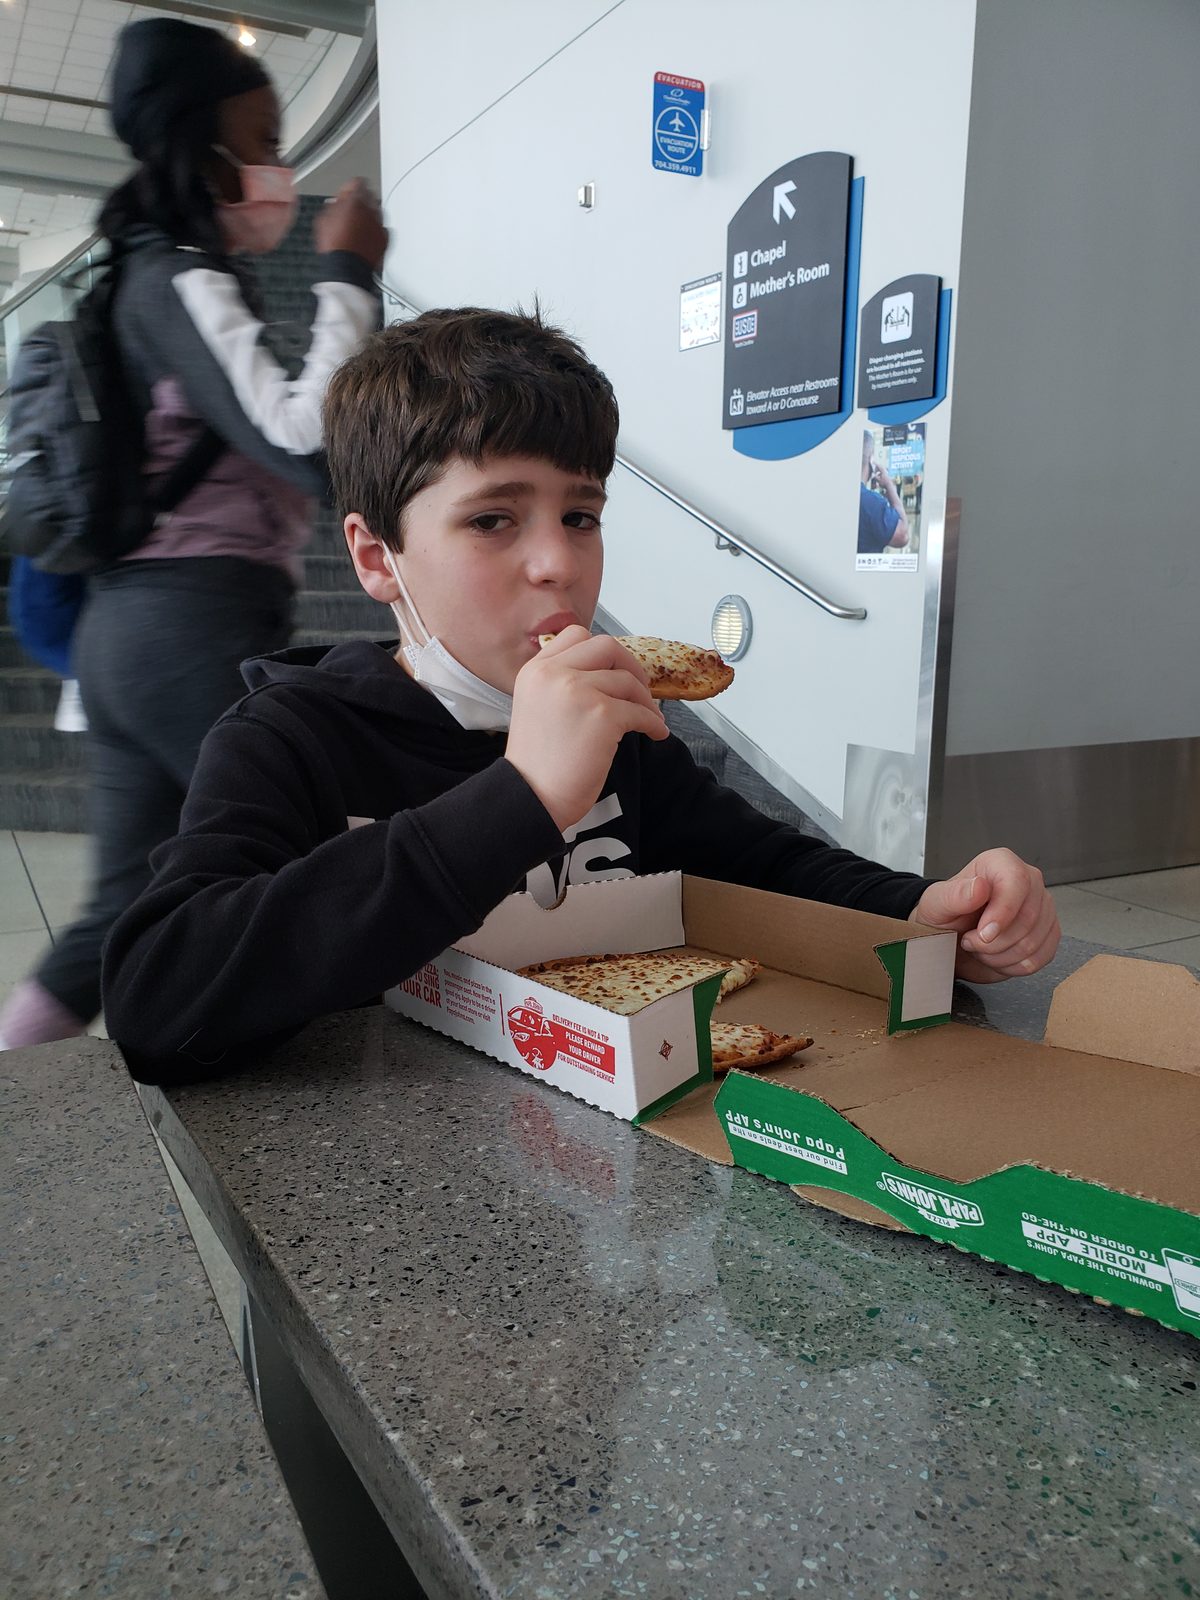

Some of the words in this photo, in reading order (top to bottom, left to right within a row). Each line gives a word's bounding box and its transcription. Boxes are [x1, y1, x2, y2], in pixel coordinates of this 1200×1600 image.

[657, 73, 702, 89] EVACUATION
[660, 137, 693, 149] EVACUATION
[667, 145, 686, 154] ROUTE
[750, 240, 787, 267] Chapel
[749, 271, 795, 299] Mother's
[796, 263, 830, 284] Room
[746, 390, 770, 402] Elevator
[769, 386, 791, 398] Access
[790, 383, 805, 394] near
[804, 377, 839, 391] Restrooms
[746, 402, 768, 415] toward
[767, 401, 773, 411] A
[773, 402, 780, 411] or
[780, 399, 787, 409] D
[787, 395, 819, 408] Concourse
[424, 973, 440, 989] SING
[423, 986, 442, 1008] CAR
[552, 1013, 573, 1028] DELIVERY
[573, 1022, 582, 1032] FEE
[582, 1025, 587, 1034] IS
[587, 1027, 597, 1039] NOT
[597, 1032, 602, 1041] A
[601, 1034, 609, 1043] TIP
[565, 1031, 584, 1046] PLEASE
[583, 1039, 605, 1055] REWARD
[568, 1044, 582, 1056] YOUR
[582, 1050, 601, 1065] DRIVER
[557, 1053, 567, 1062] FOR
[566, 1055, 596, 1076] OUTSTANDING
[596, 1069, 615, 1084] SERVICE
[725, 1109, 749, 1127] APP
[732, 1126, 746, 1136] the
[747, 1131, 758, 1140] on
[753, 1118, 801, 1144] John's
[759, 1135, 781, 1149] deals
[784, 1144, 804, 1157] best
[806, 1135, 846, 1161] Papa
[806, 1152, 821, 1162] our
[824, 1158, 843, 1171] Find
[938, 1195, 980, 1221] PAPA
[927, 1213, 951, 1227] PIZZA
[1021, 1211, 1088, 1239] ON-THE-GO
[1036, 1229, 1070, 1247] APP
[1091, 1234, 1135, 1255] ORDER
[1026, 1239, 1059, 1256] JOHN'S
[1139, 1249, 1159, 1263] TO
[1061, 1251, 1085, 1266] PAPA
[1080, 1242, 1147, 1274] MOBILE
[1086, 1260, 1106, 1273] THE
[1107, 1266, 1163, 1293] DOWNLOAD
